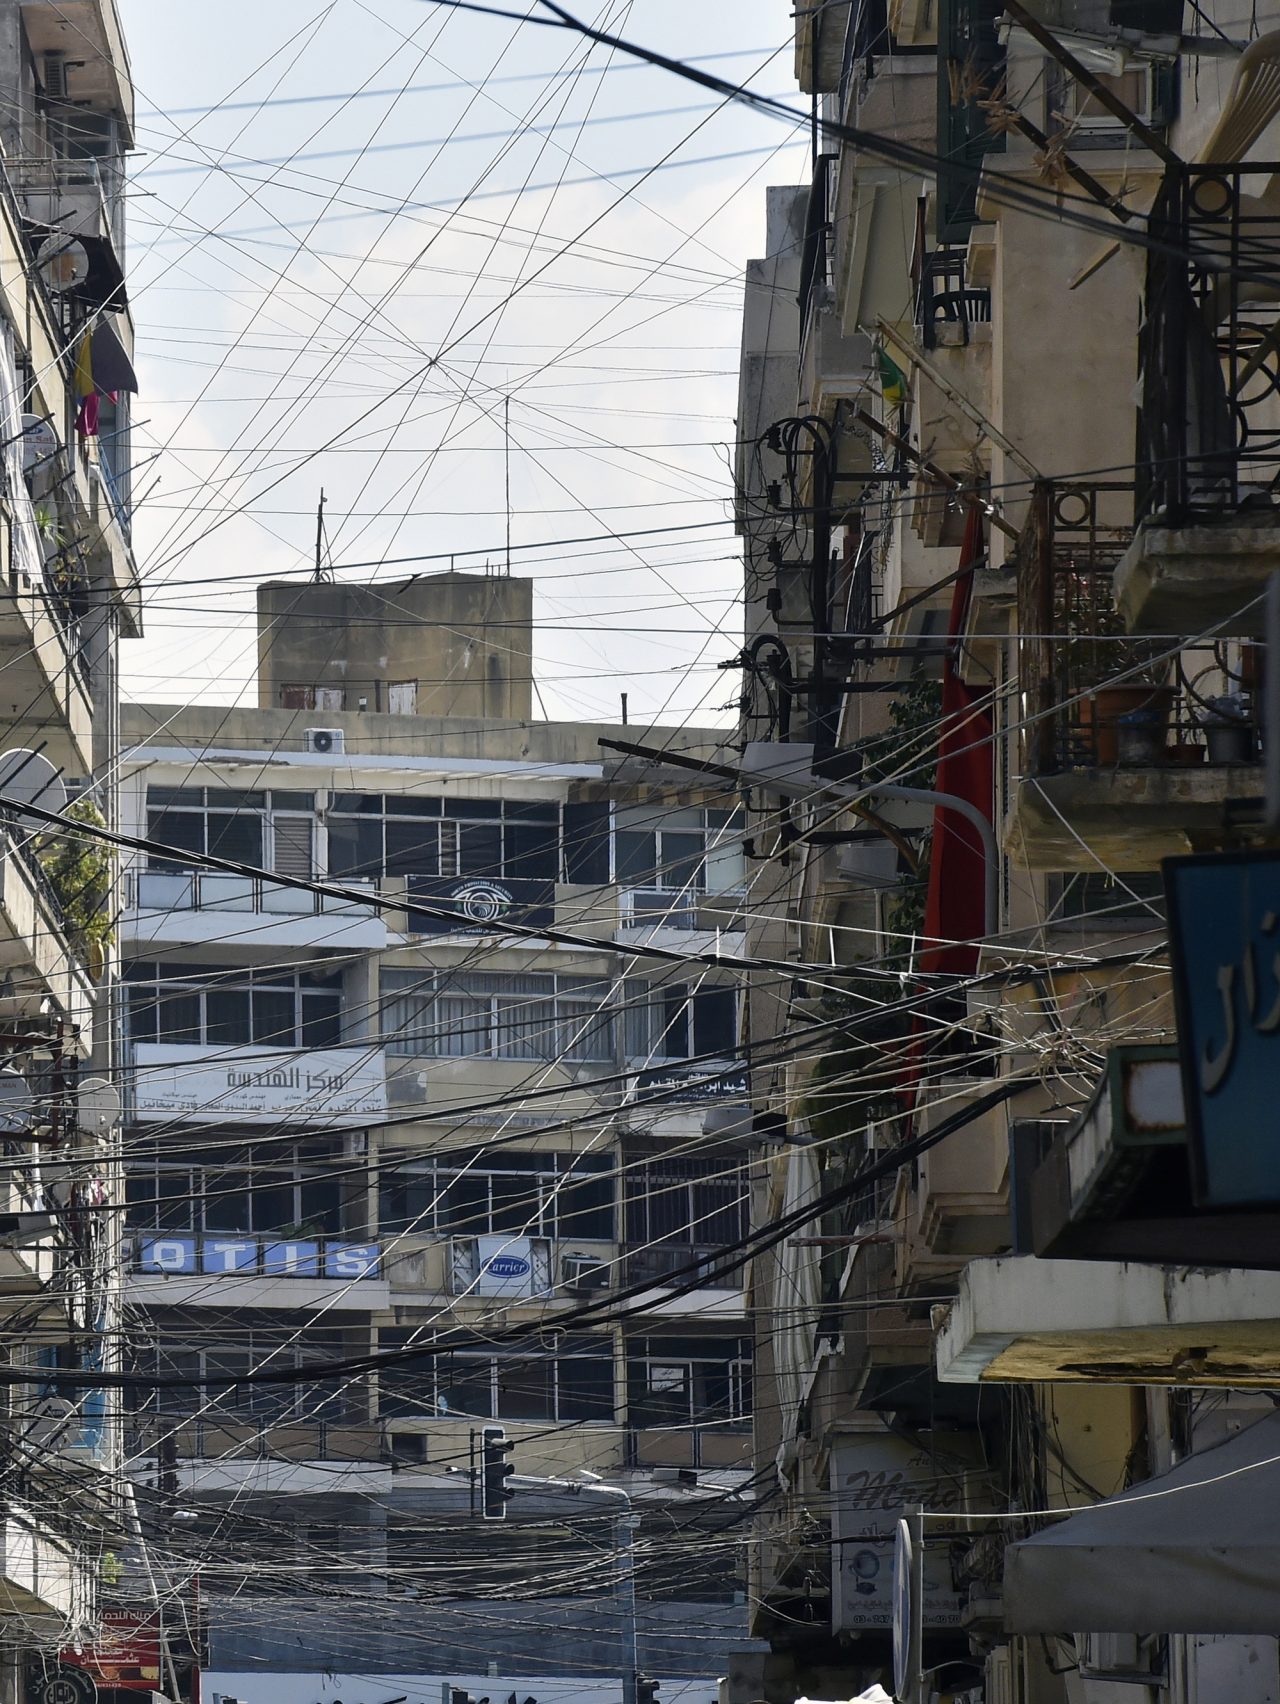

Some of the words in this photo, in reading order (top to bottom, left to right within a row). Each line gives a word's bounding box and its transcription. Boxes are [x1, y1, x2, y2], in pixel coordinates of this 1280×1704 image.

[227, 1067, 299, 1088] الهندسة
[306, 1068, 344, 1092] مركز
[153, 1242, 369, 1273] OTIS
